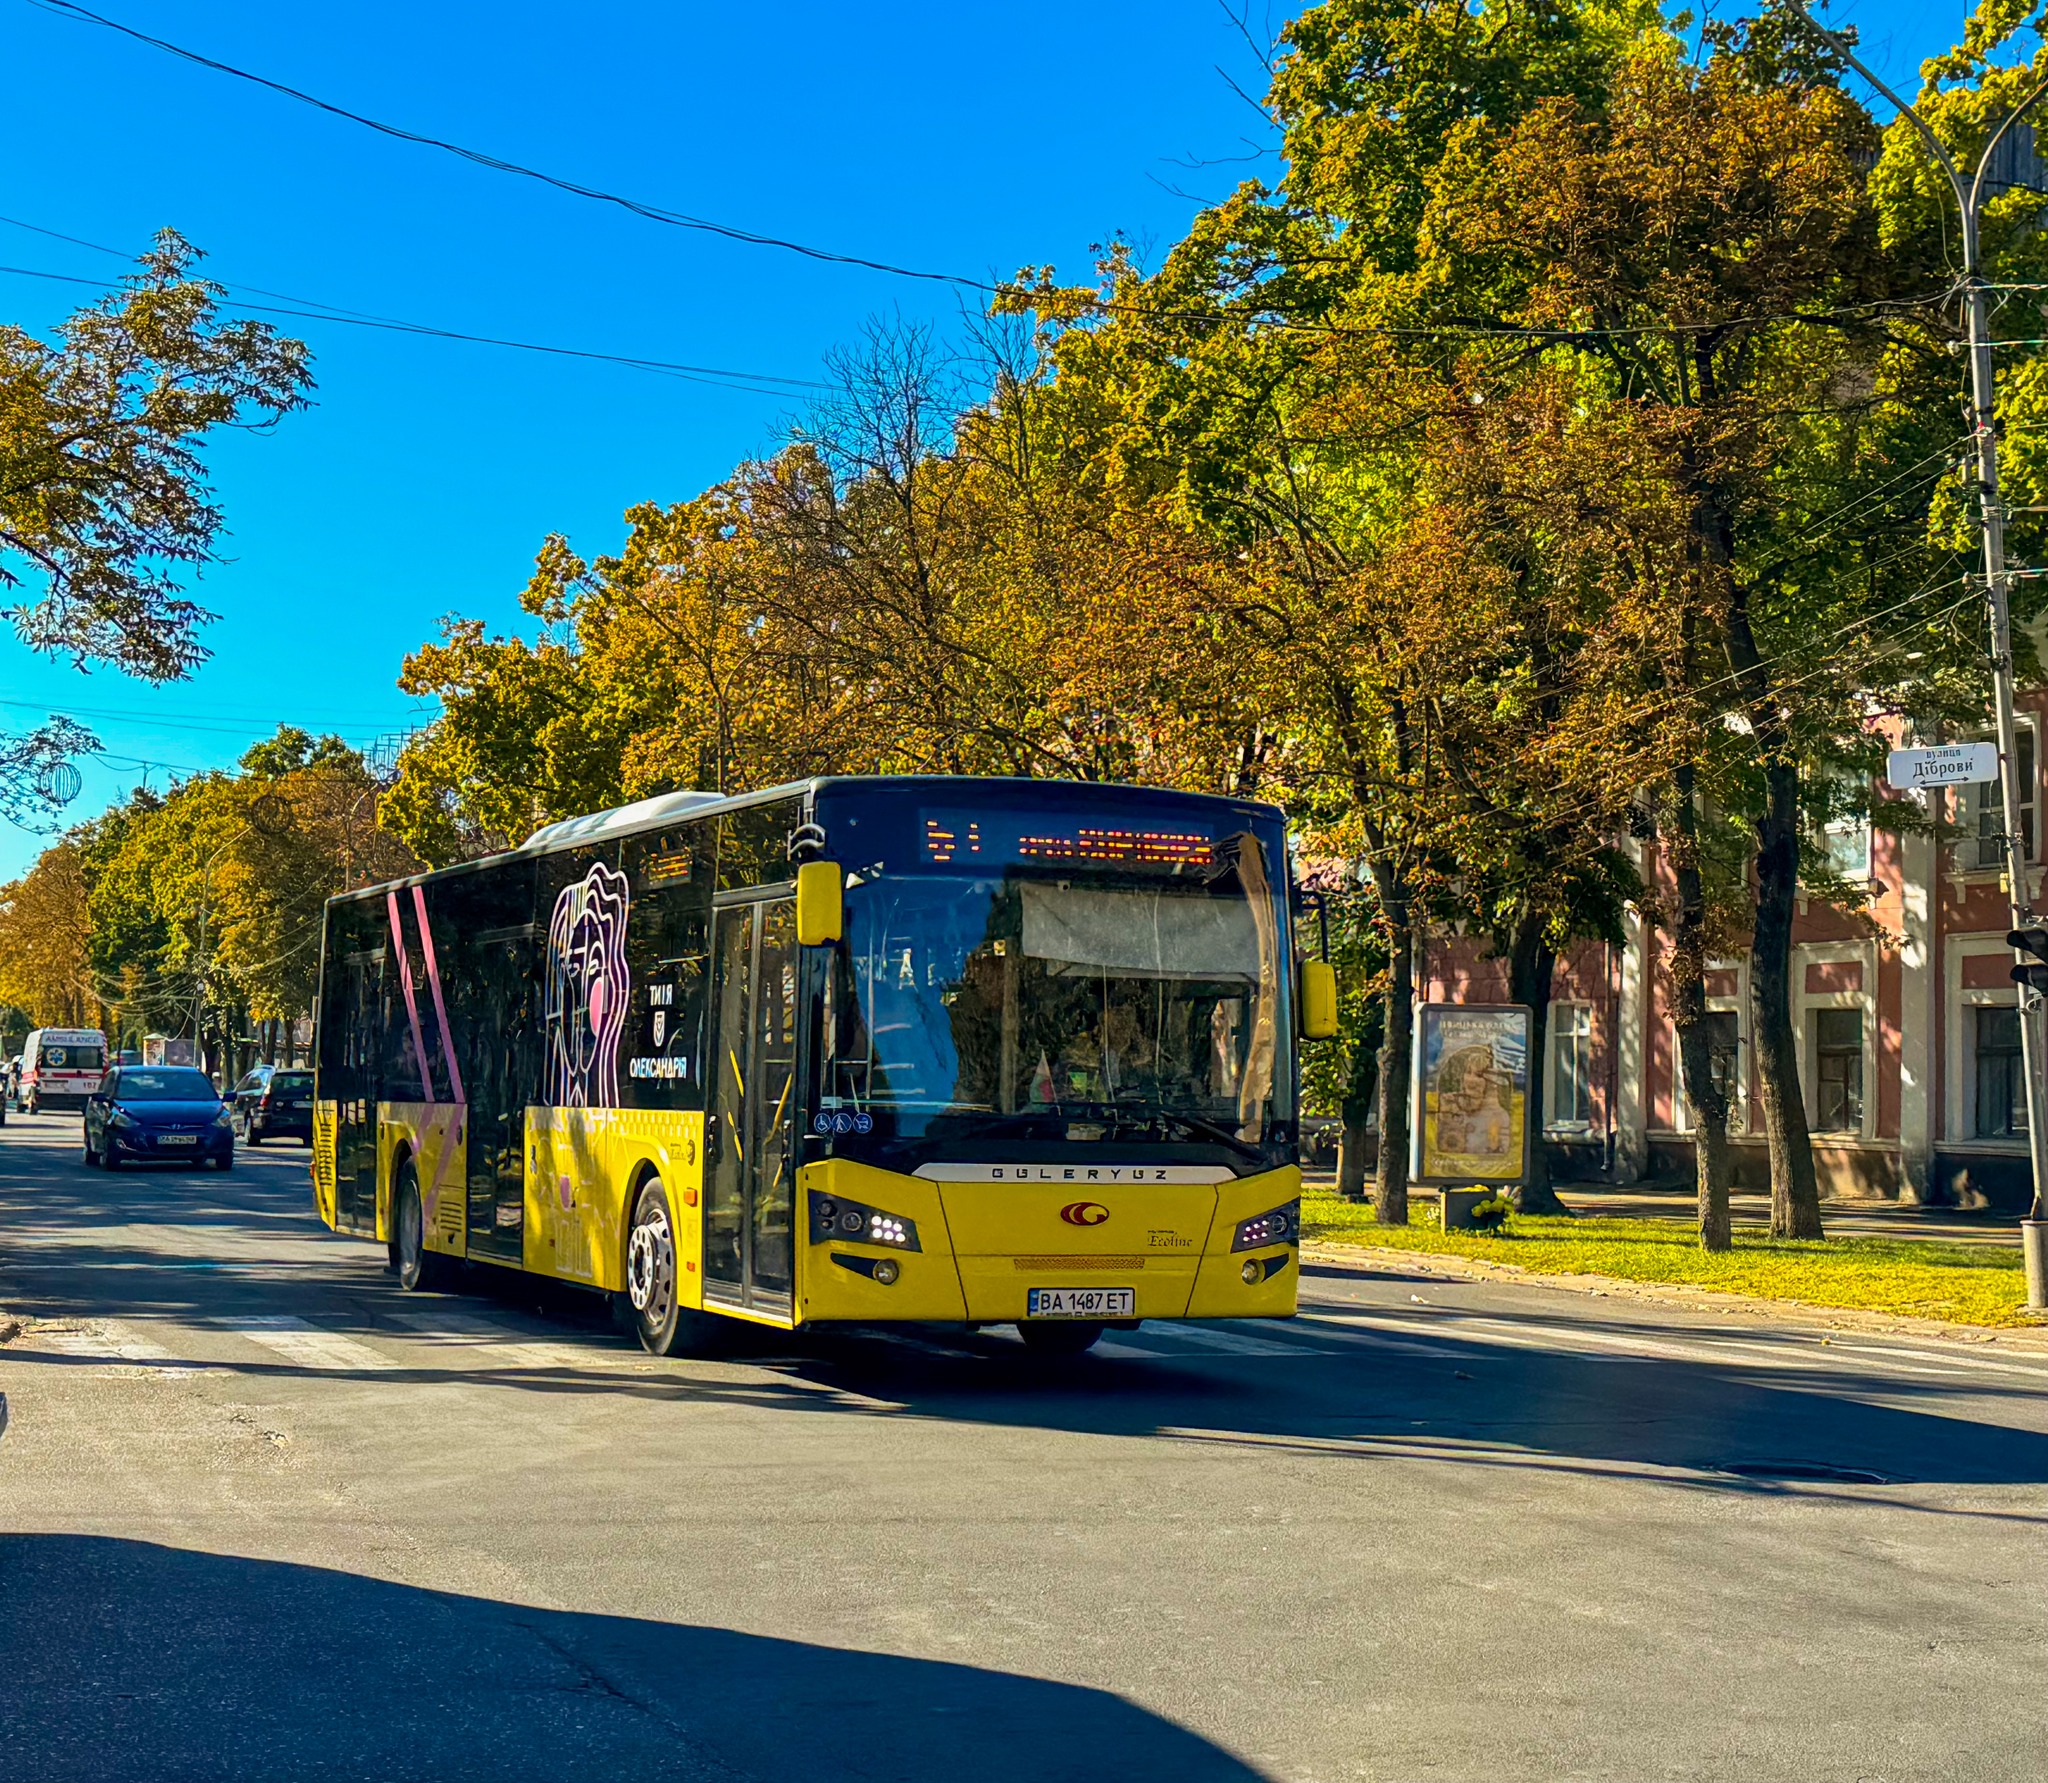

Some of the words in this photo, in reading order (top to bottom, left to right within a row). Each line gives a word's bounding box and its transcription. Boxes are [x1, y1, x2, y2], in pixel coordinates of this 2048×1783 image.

[1041, 1293, 1063, 1310] BA
[1068, 1293, 1104, 1310] 1487
[1107, 1292, 1129, 1310] ET
